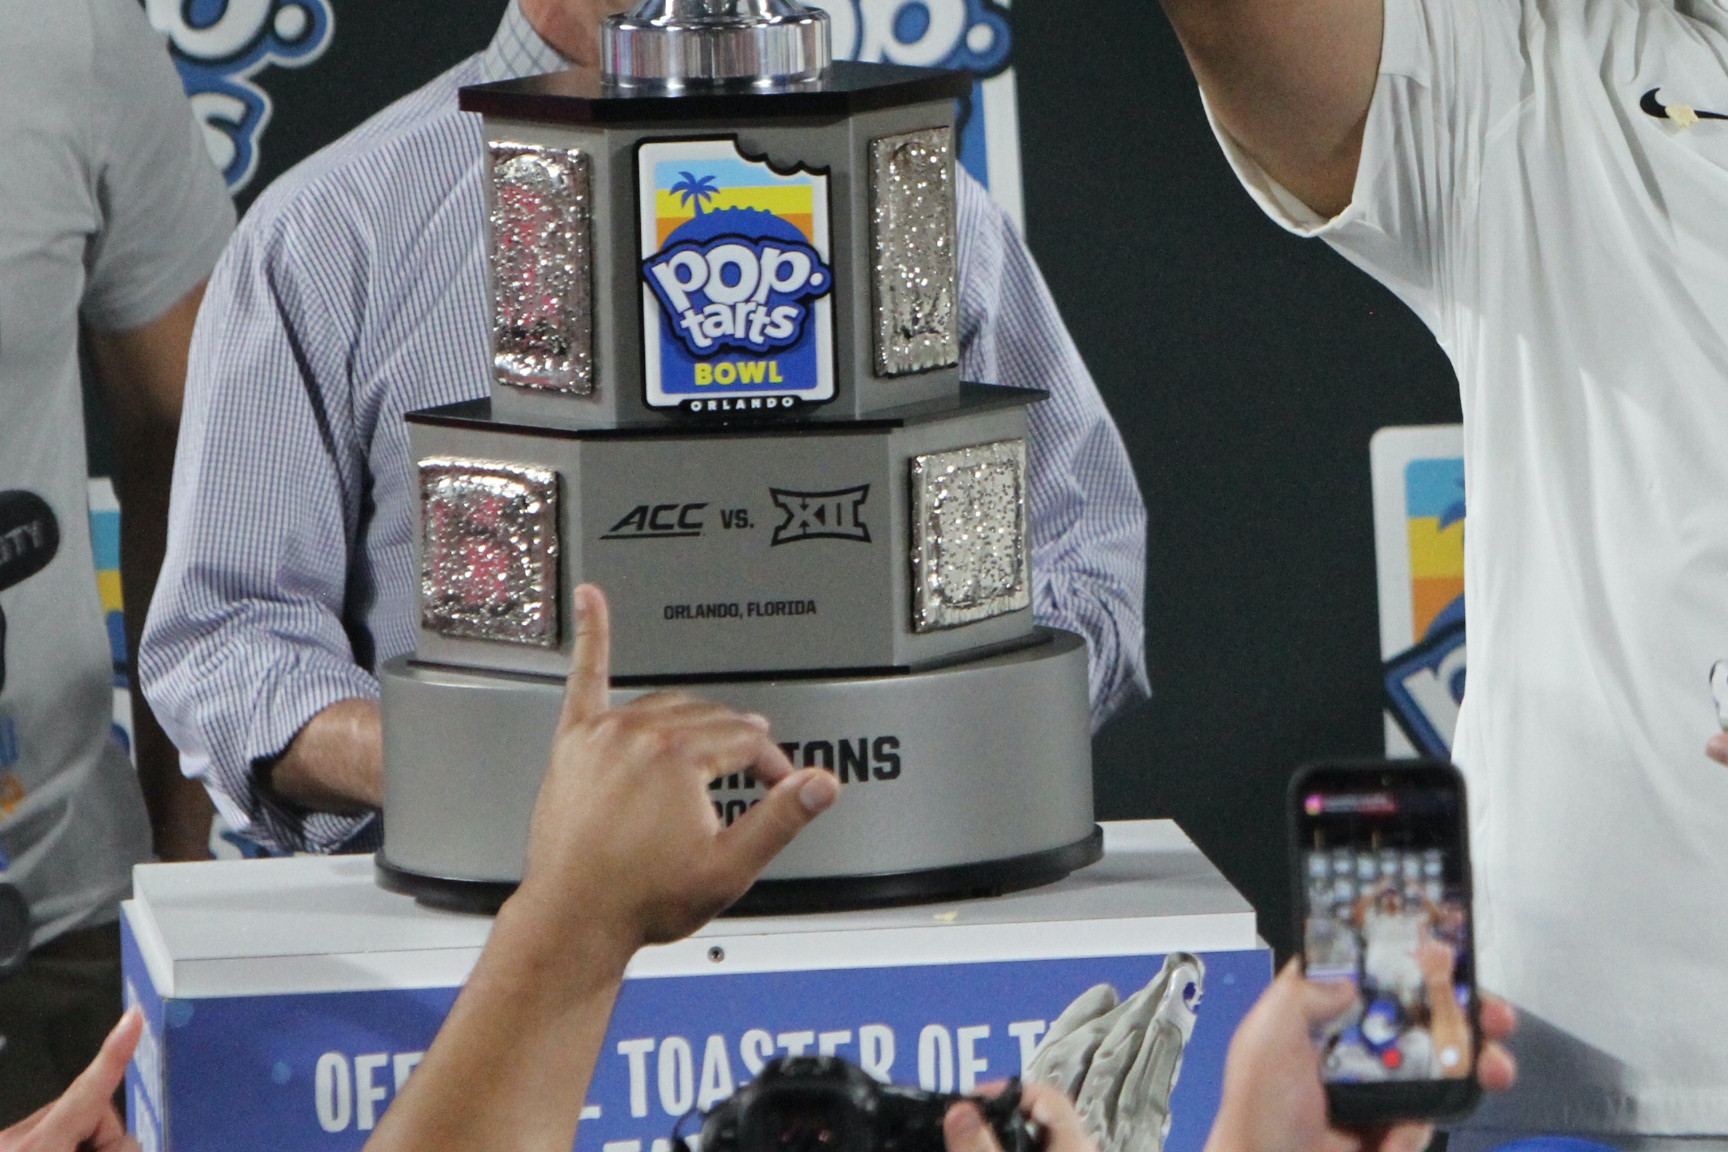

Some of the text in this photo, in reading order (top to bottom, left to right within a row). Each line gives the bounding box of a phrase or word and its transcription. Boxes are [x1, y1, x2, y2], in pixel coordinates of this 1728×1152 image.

[680, 301, 799, 348] tarts
[694, 361, 783, 386] BOWL
[690, 397, 794, 412] ORLANDO
[605, 502, 709, 536] ACC
[720, 508, 754, 529] VS.
[663, 600, 817, 620] ORLANDO, FLORIDA
[918, 1024, 990, 1095] OF
